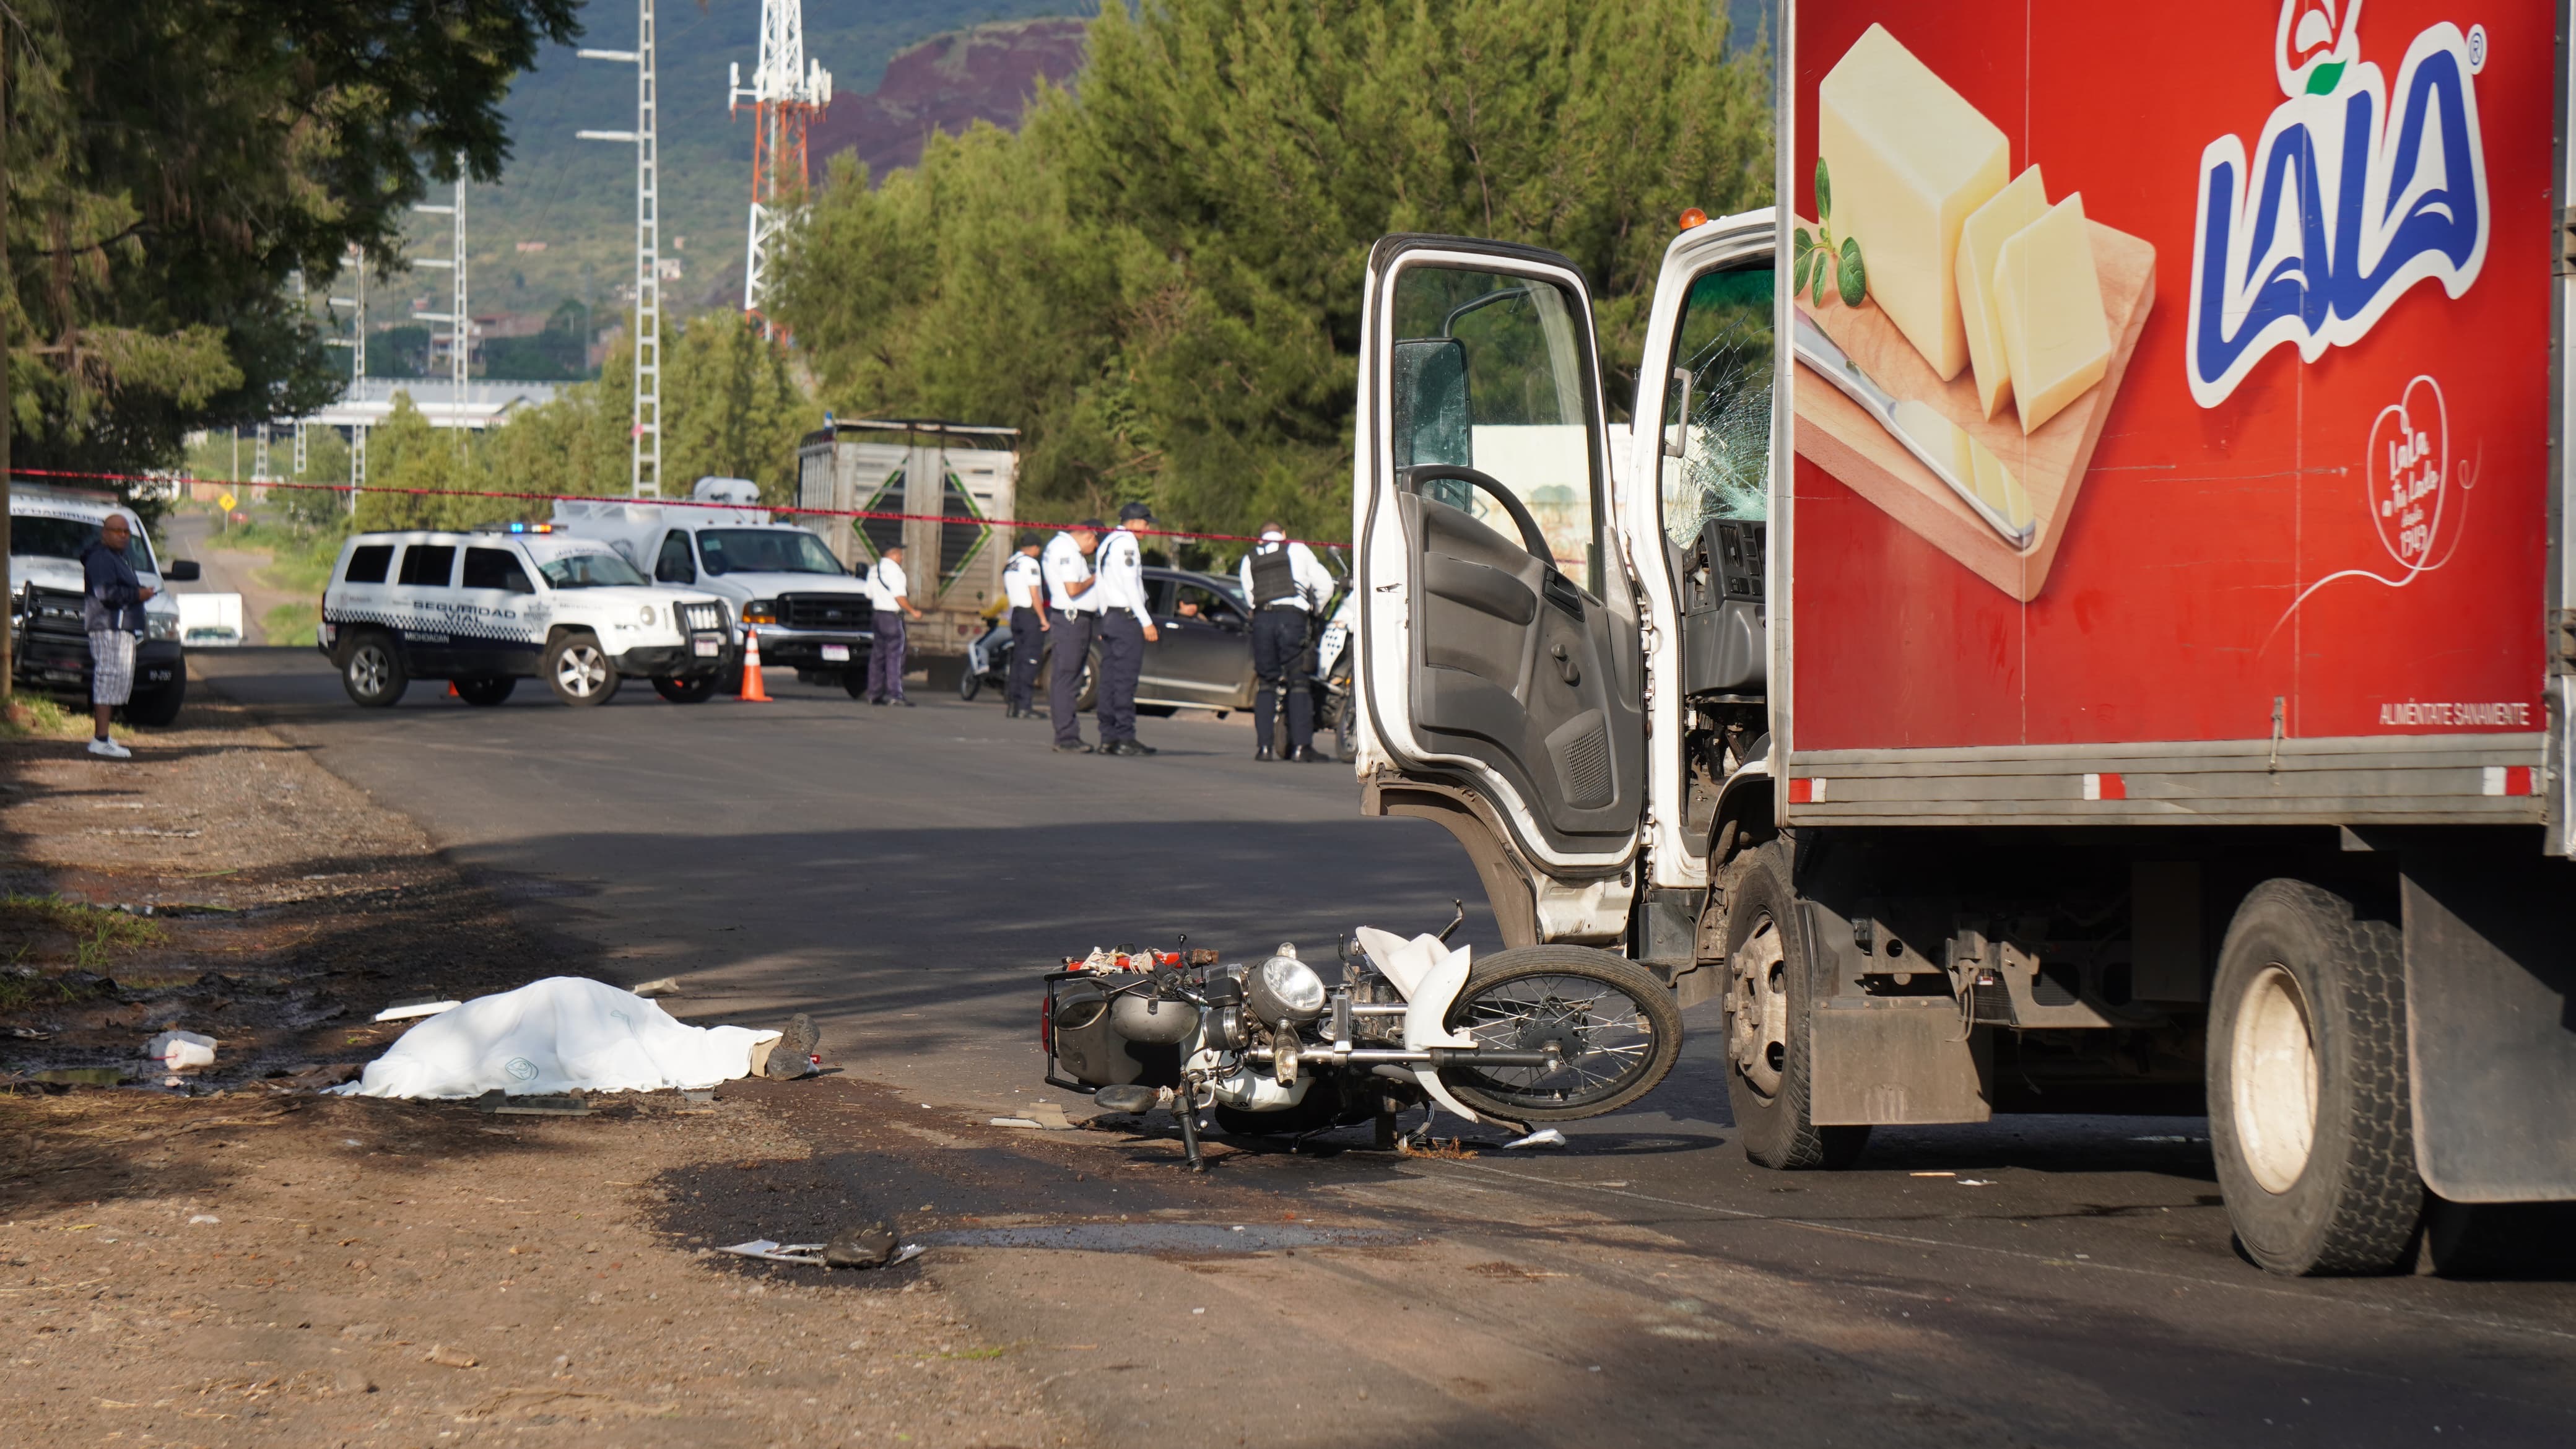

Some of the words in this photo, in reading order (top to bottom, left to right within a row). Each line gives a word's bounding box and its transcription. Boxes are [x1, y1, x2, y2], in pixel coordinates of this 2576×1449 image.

[2197, 49, 2478, 384] LALA
[2400, 524, 2429, 558] 1949
[414, 599, 516, 619] SEGURIDAD
[405, 630, 450, 645] MICHOACAN
[2379, 697, 2453, 725] ALIMÉNTATE
[2453, 703, 2530, 726] SANAMENTE
